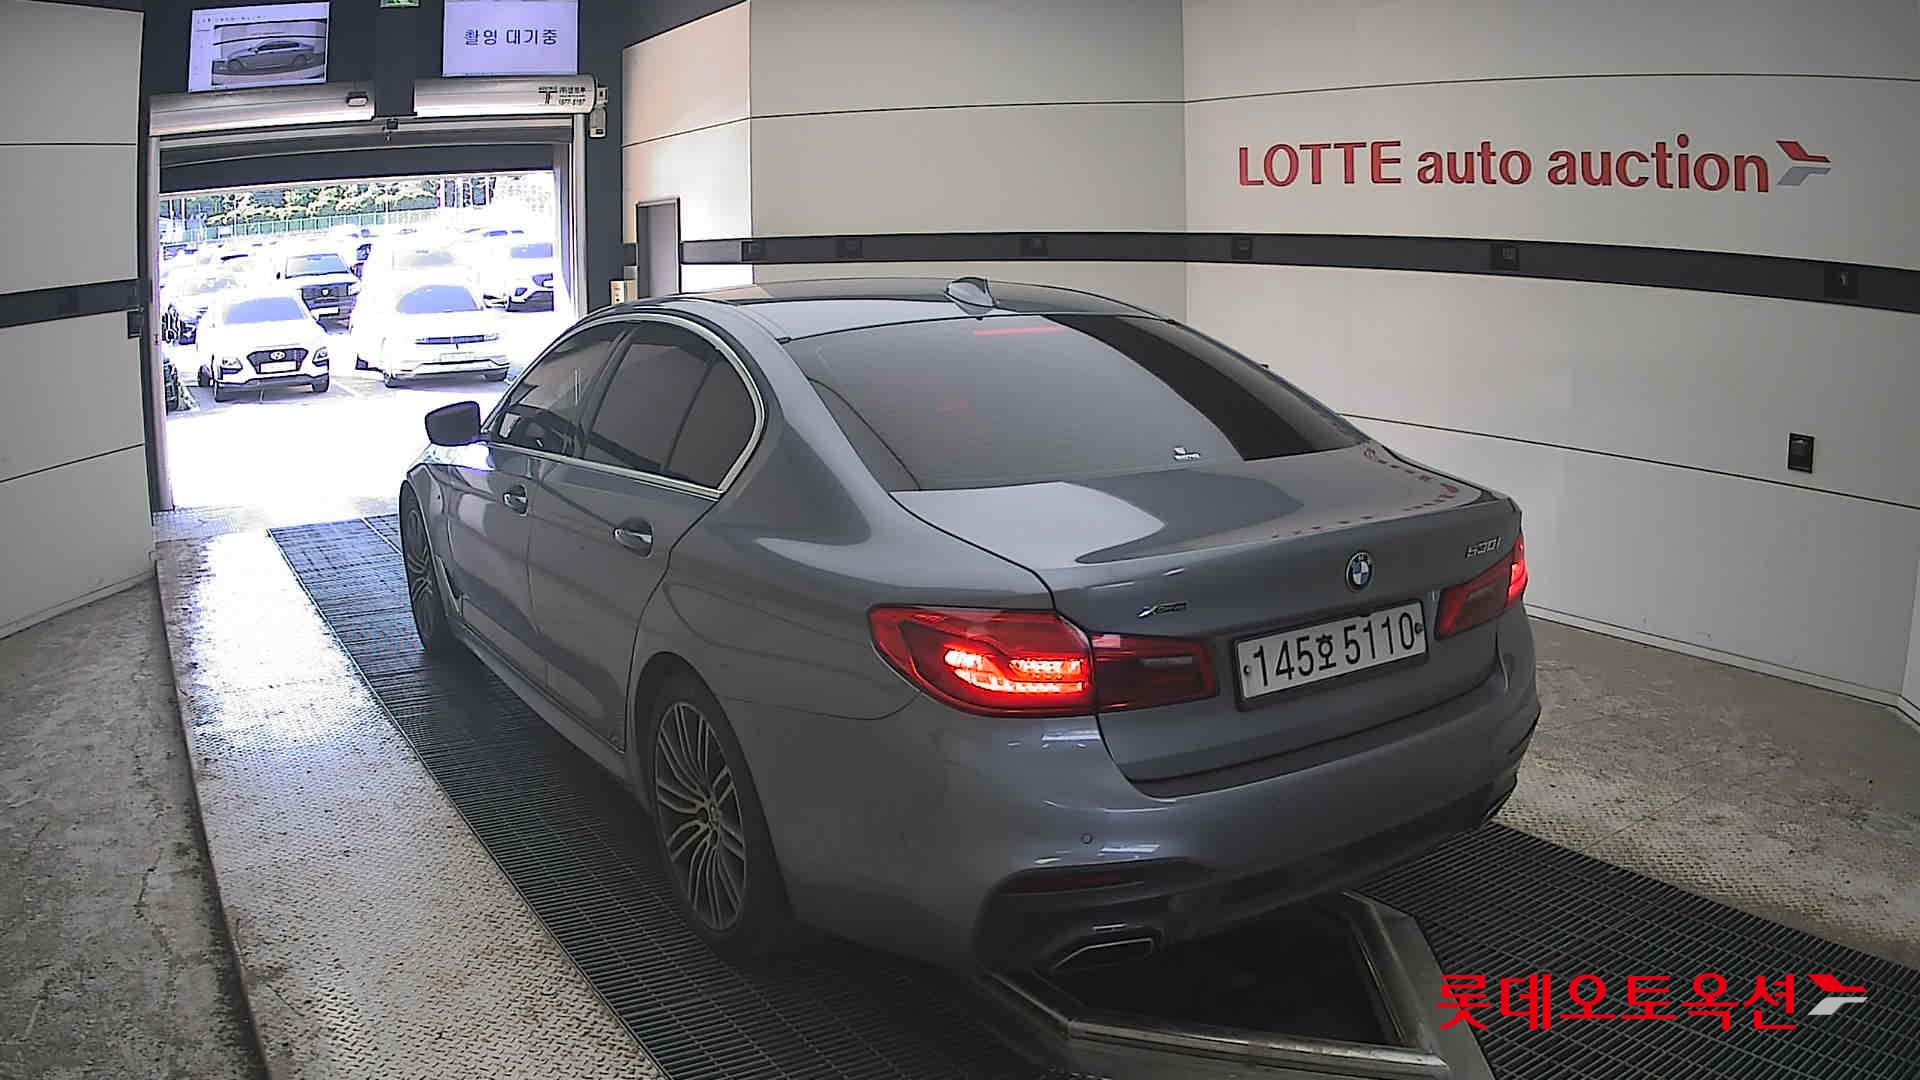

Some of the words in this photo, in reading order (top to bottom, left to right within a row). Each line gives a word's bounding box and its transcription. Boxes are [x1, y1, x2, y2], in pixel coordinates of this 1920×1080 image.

[505, 28, 558, 46] 대기중
[1238, 141, 1402, 187] LOTTE
[1416, 141, 1532, 186] auto
[1547, 133, 1770, 193] auction
